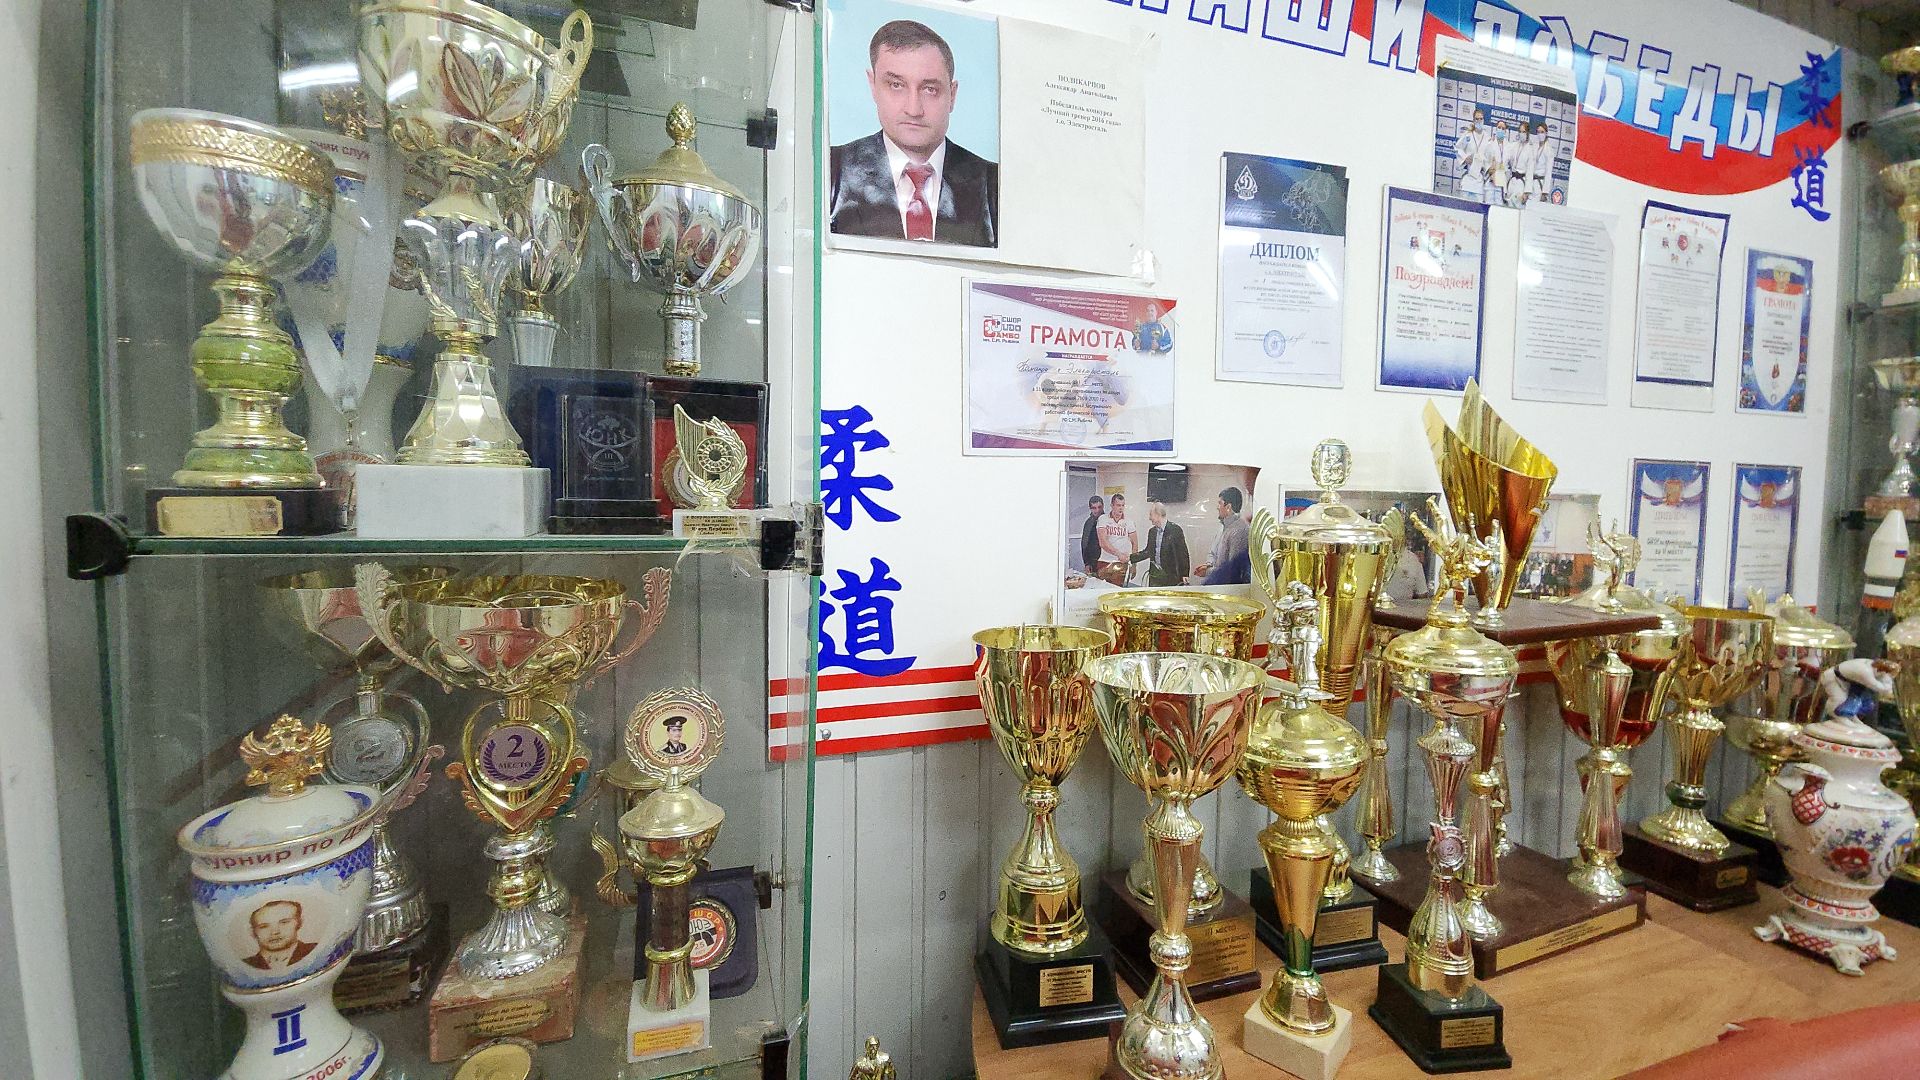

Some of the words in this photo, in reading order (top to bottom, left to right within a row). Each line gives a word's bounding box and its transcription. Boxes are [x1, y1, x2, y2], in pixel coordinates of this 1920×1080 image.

[1058, 74, 1106, 90] ПОЛИКАРПОВ
[1044, 82, 1077, 93] Александр
[1079, 88, 1118, 101] Анатольевич
[1086, 107, 1113, 117] конкурса
[1091, 115, 1105, 123] 2016
[342, 146, 370, 160] служ
[1250, 242, 1320, 262] ДИПЛОМ
[1030, 325, 1128, 350] ГРАМОТА
[1105, 525, 1127, 537] RUSSIA
[507, 734, 524, 757] 2
[498, 761, 532, 770] МЕСТО
[203, 850, 291, 870] урнир
[303, 837, 333, 855] по
[272, 1003, 308, 1056] II
